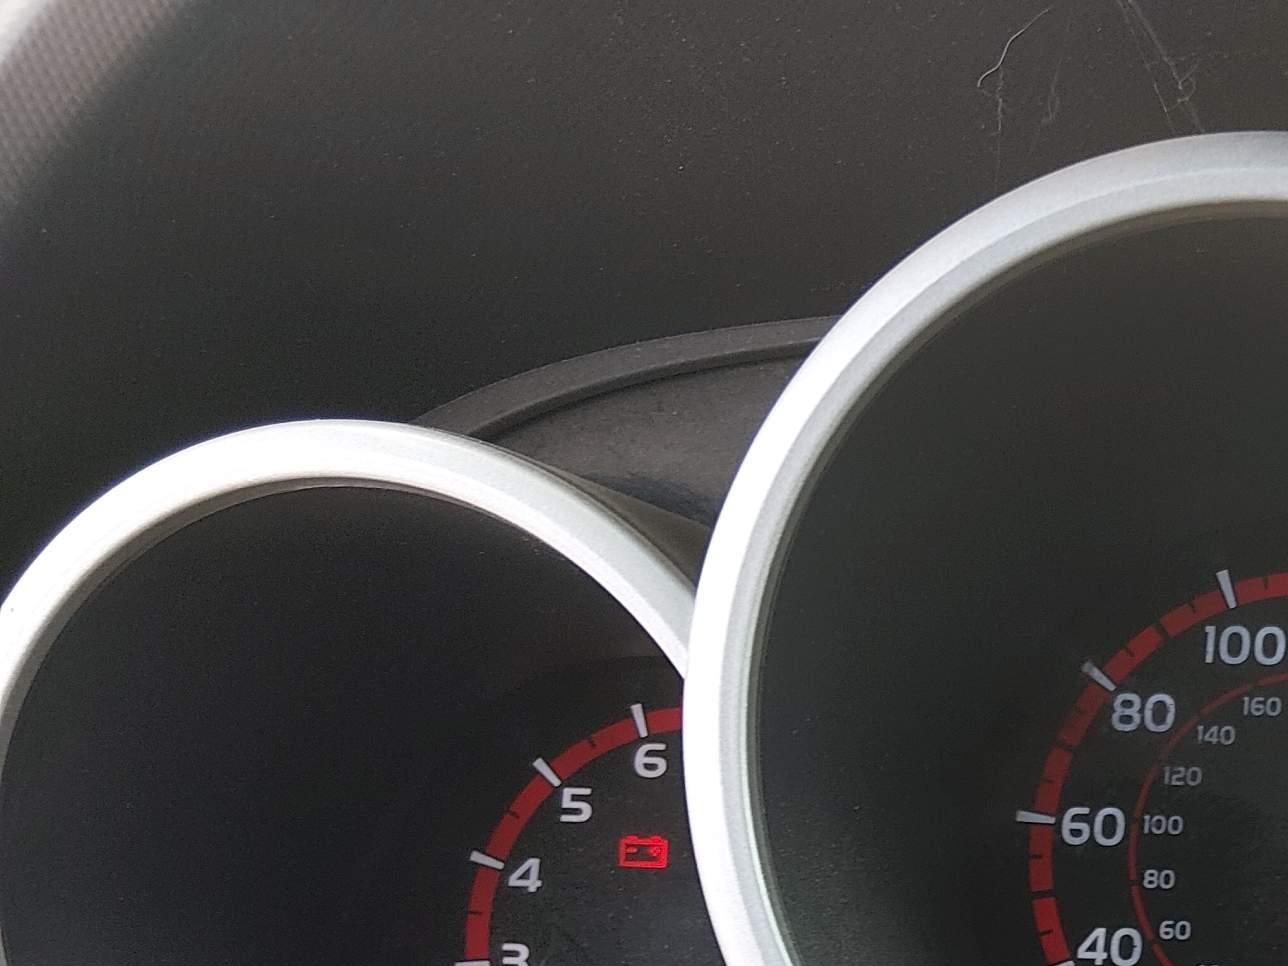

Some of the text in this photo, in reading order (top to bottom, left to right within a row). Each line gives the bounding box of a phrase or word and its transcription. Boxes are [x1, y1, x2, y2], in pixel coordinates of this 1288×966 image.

[1204, 625, 1287, 665] 100
[1111, 693, 1176, 733] 80
[1243, 697, 1282, 717] 160
[1197, 726, 1236, 746] 140
[635, 743, 667, 778] 6
[1163, 767, 1202, 787] 120
[560, 787, 592, 823] 5
[1061, 807, 1125, 847] 60
[1143, 815, 1183, 835] 100
[508, 858, 542, 893] 4
[1143, 869, 1175, 889] 80
[1077, 927, 1142, 966] 40
[1159, 921, 1191, 940] 60
